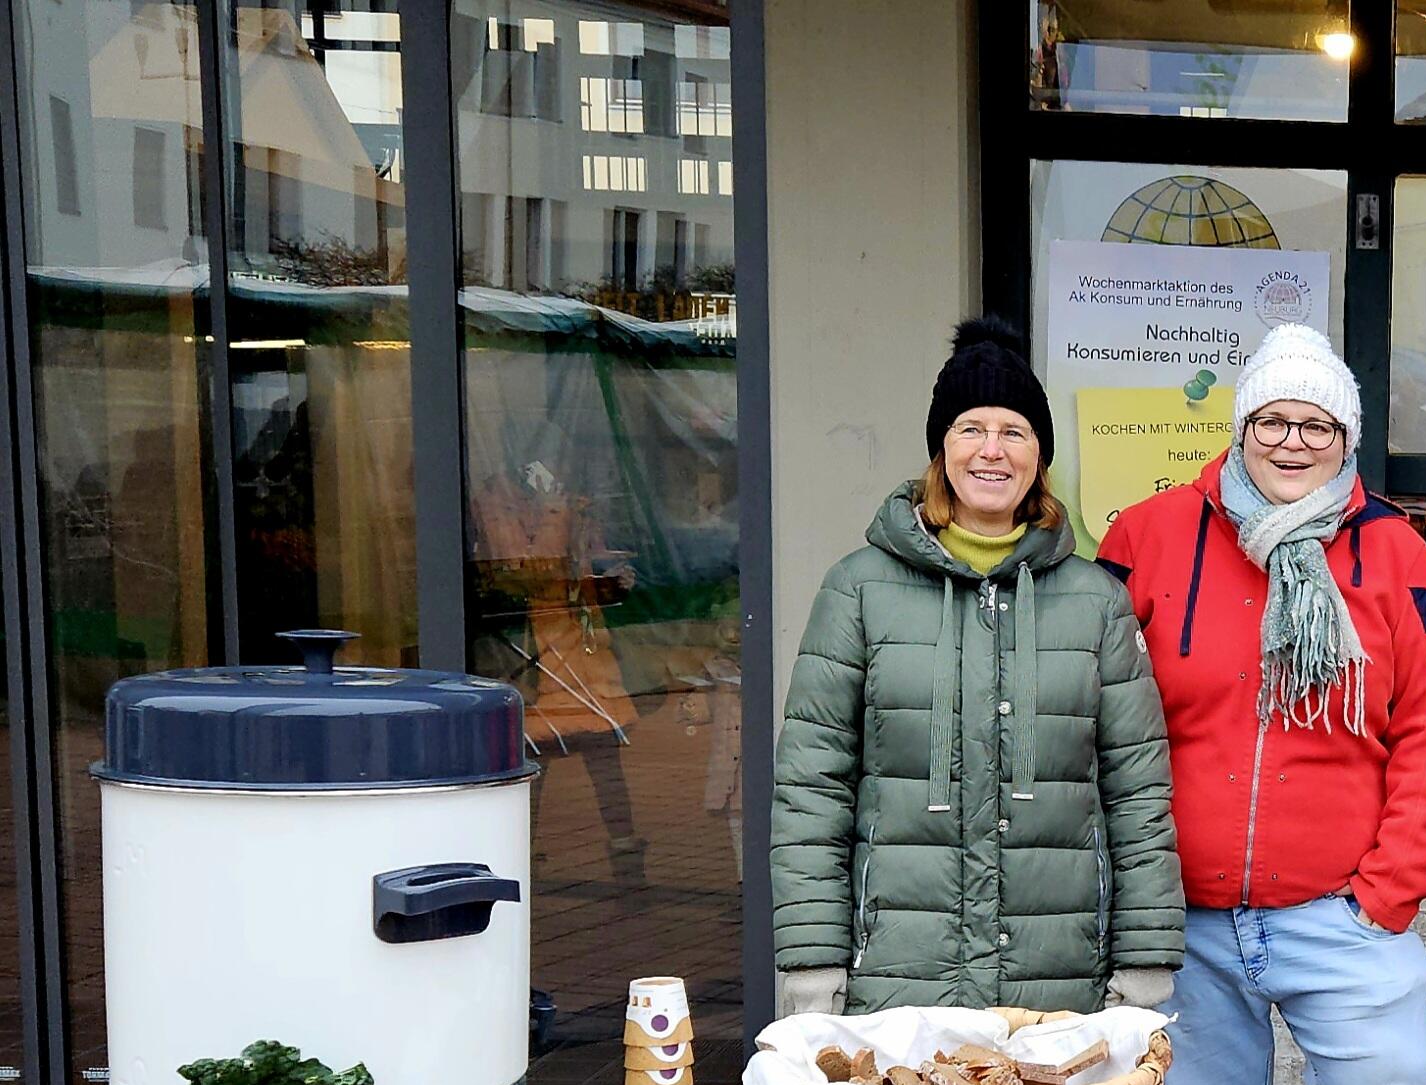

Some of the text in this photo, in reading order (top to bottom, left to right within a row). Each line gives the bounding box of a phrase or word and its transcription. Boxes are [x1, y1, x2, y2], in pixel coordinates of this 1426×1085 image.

[1078, 275, 1234, 295] Wochenmarktaktion des
[1255, 271, 1311, 295] AGENDA 21
[1068, 291, 1243, 313] Ak Konsum und Ernährung
[1146, 323, 1241, 348] Nachhaltig
[1067, 342, 1182, 364] Konsumieren
[1188, 349, 1220, 365] und
[1092, 424, 1146, 435] KOCHEN
[1150, 423, 1171, 434] MIT
[1168, 449, 1212, 462] heute:
